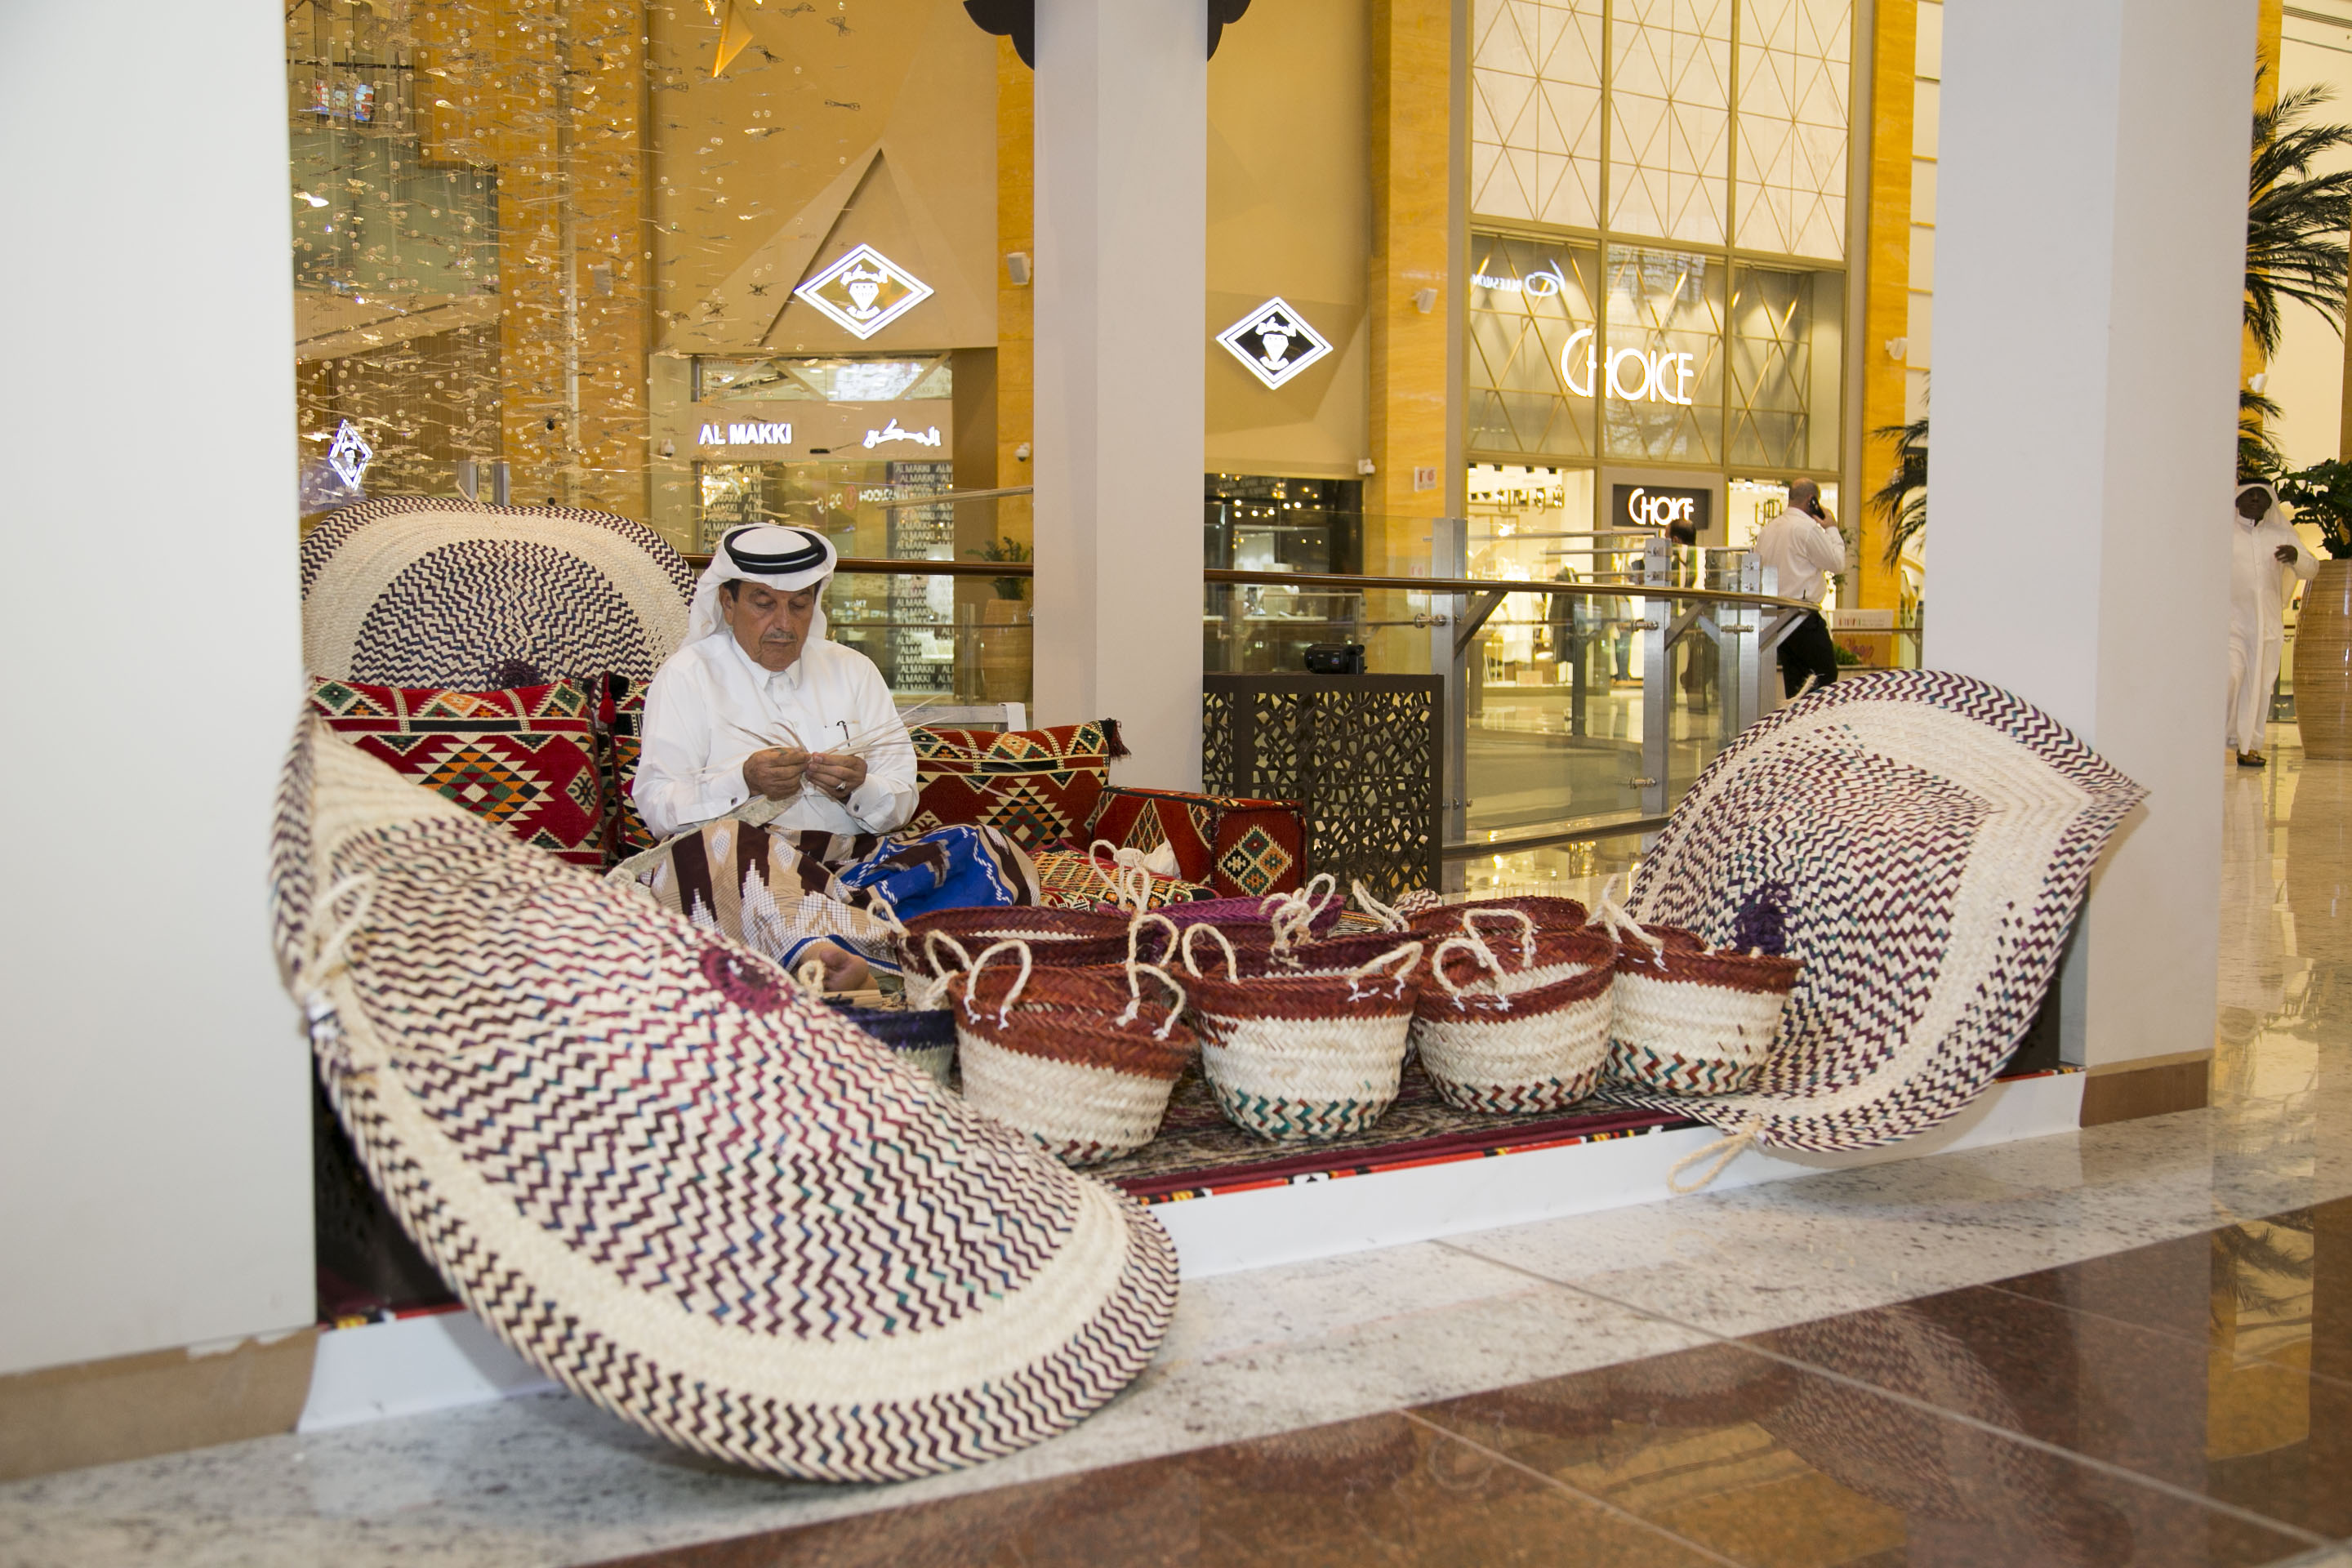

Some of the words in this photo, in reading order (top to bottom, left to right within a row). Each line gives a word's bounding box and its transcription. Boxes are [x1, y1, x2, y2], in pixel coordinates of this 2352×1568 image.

[1561, 327, 1694, 406] CHOICE
[697, 423, 726, 445] AL
[728, 423, 792, 445] MAKKI
